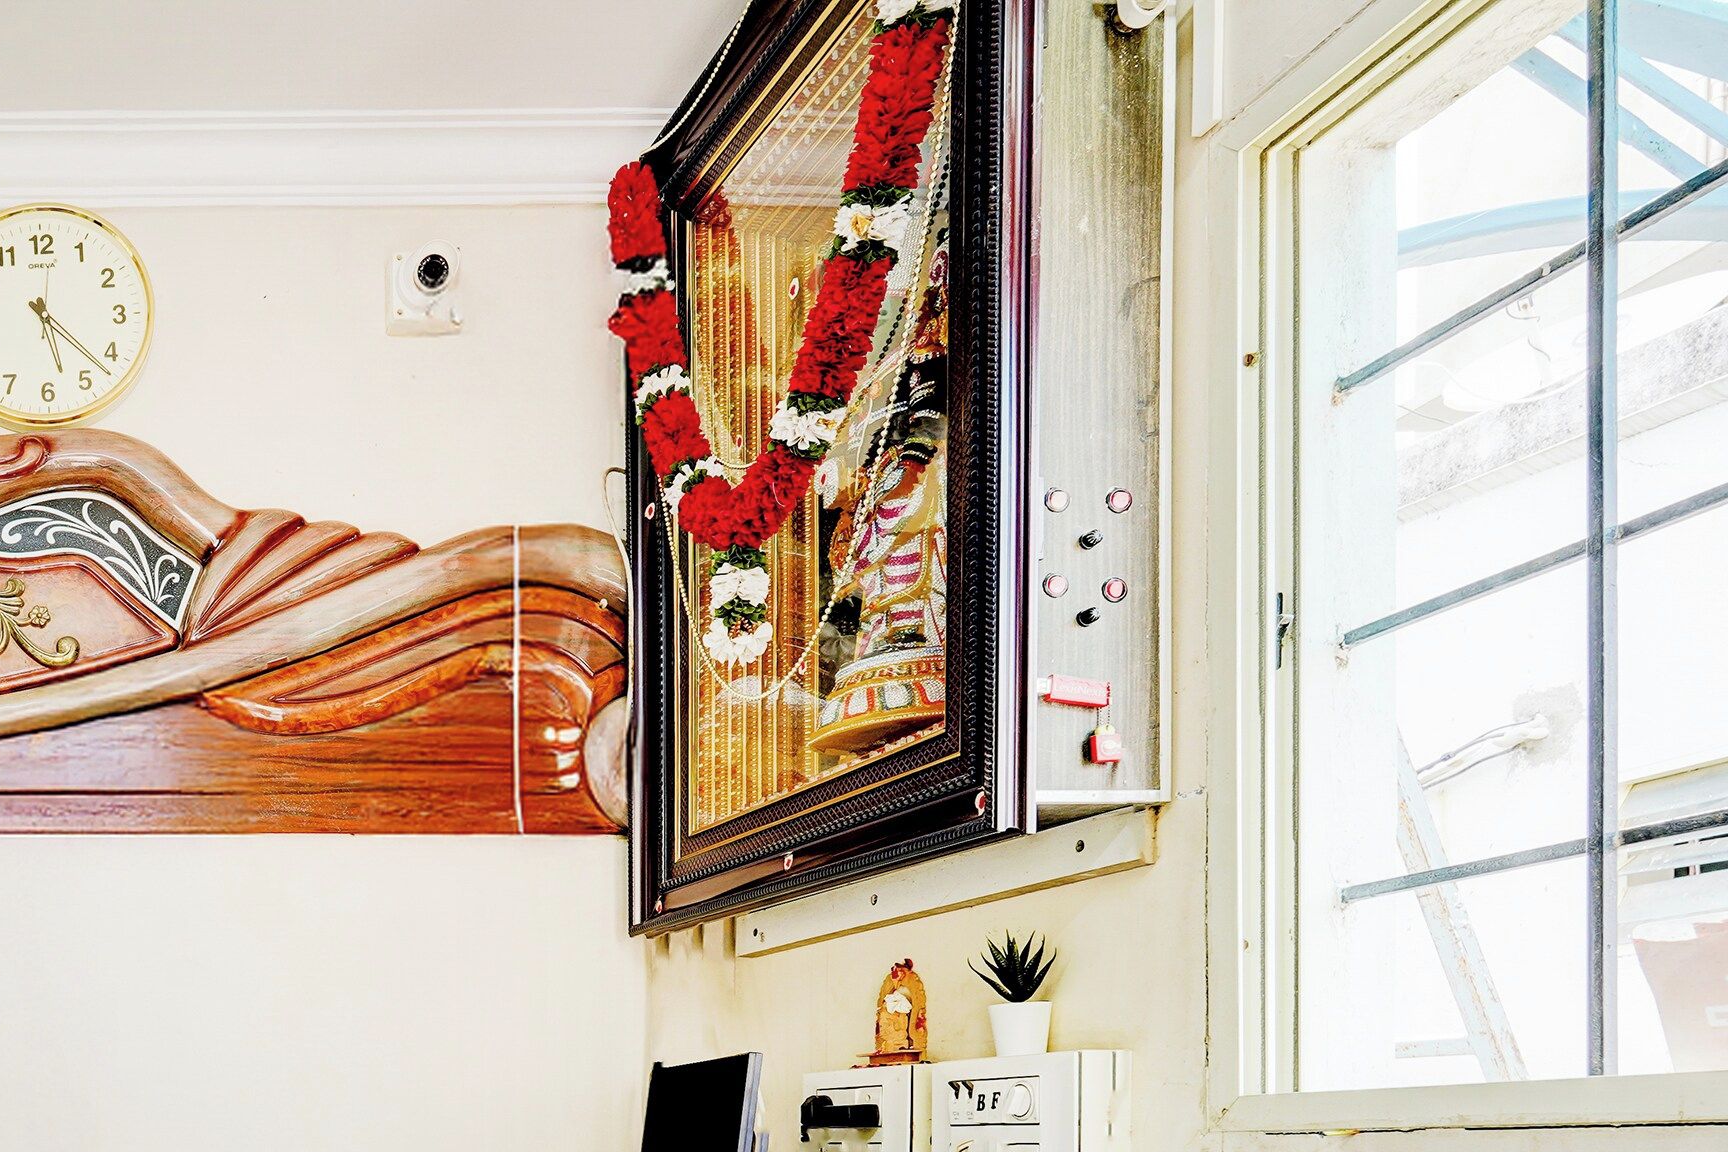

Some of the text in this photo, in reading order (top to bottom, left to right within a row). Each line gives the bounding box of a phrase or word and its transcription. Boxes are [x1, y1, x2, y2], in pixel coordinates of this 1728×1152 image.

[28, 233, 55, 255] 12
[74, 242, 84, 263] 1
[27, 262, 56, 270] OREVA
[100, 267, 116, 288] 2
[112, 304, 127, 325] 3
[104, 341, 118, 362] 4
[2, 373, 17, 395] 7
[78, 370, 93, 391] 5
[41, 382, 56, 403] 6
